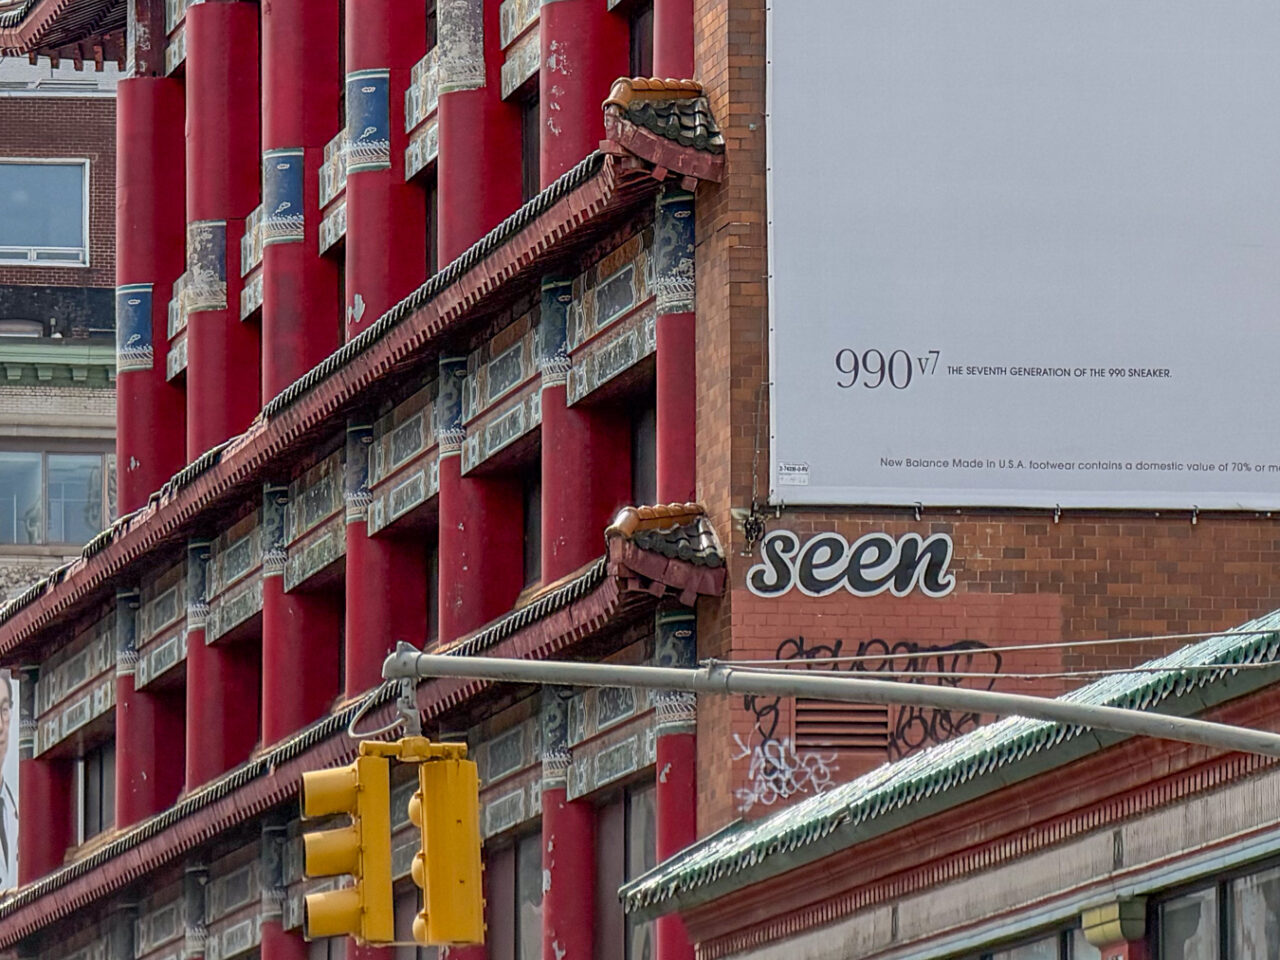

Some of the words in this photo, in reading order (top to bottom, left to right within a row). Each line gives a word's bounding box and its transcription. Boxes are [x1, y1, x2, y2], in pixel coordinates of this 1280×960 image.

[947, 365, 964, 376] THE
[966, 365, 1007, 376] SEVENTH
[1009, 366, 1071, 377] GENERATION
[1073, 367, 1088, 378] OF
[1089, 368, 1106, 378] THE
[1108, 367, 1126, 378] 990
[1127, 367, 1173, 378] SNEAKER.
[880, 457, 903, 467] New
[905, 457, 950, 468] Balance
[952, 458, 984, 469] Made
[986, 458, 996, 469] in
[998, 459, 1027, 470] U.S.A.
[1029, 459, 1076, 471] footwear
[1077, 460, 1123, 471] contains
[1124, 462, 1133, 471] a
[1135, 460, 1184, 472] domestic
[1186, 462, 1216, 472] value
[1217, 461, 1229, 472] of
[1231, 461, 1252, 472] 70%
[1254, 464, 1266, 473] or
[746, 529, 956, 598] seen
